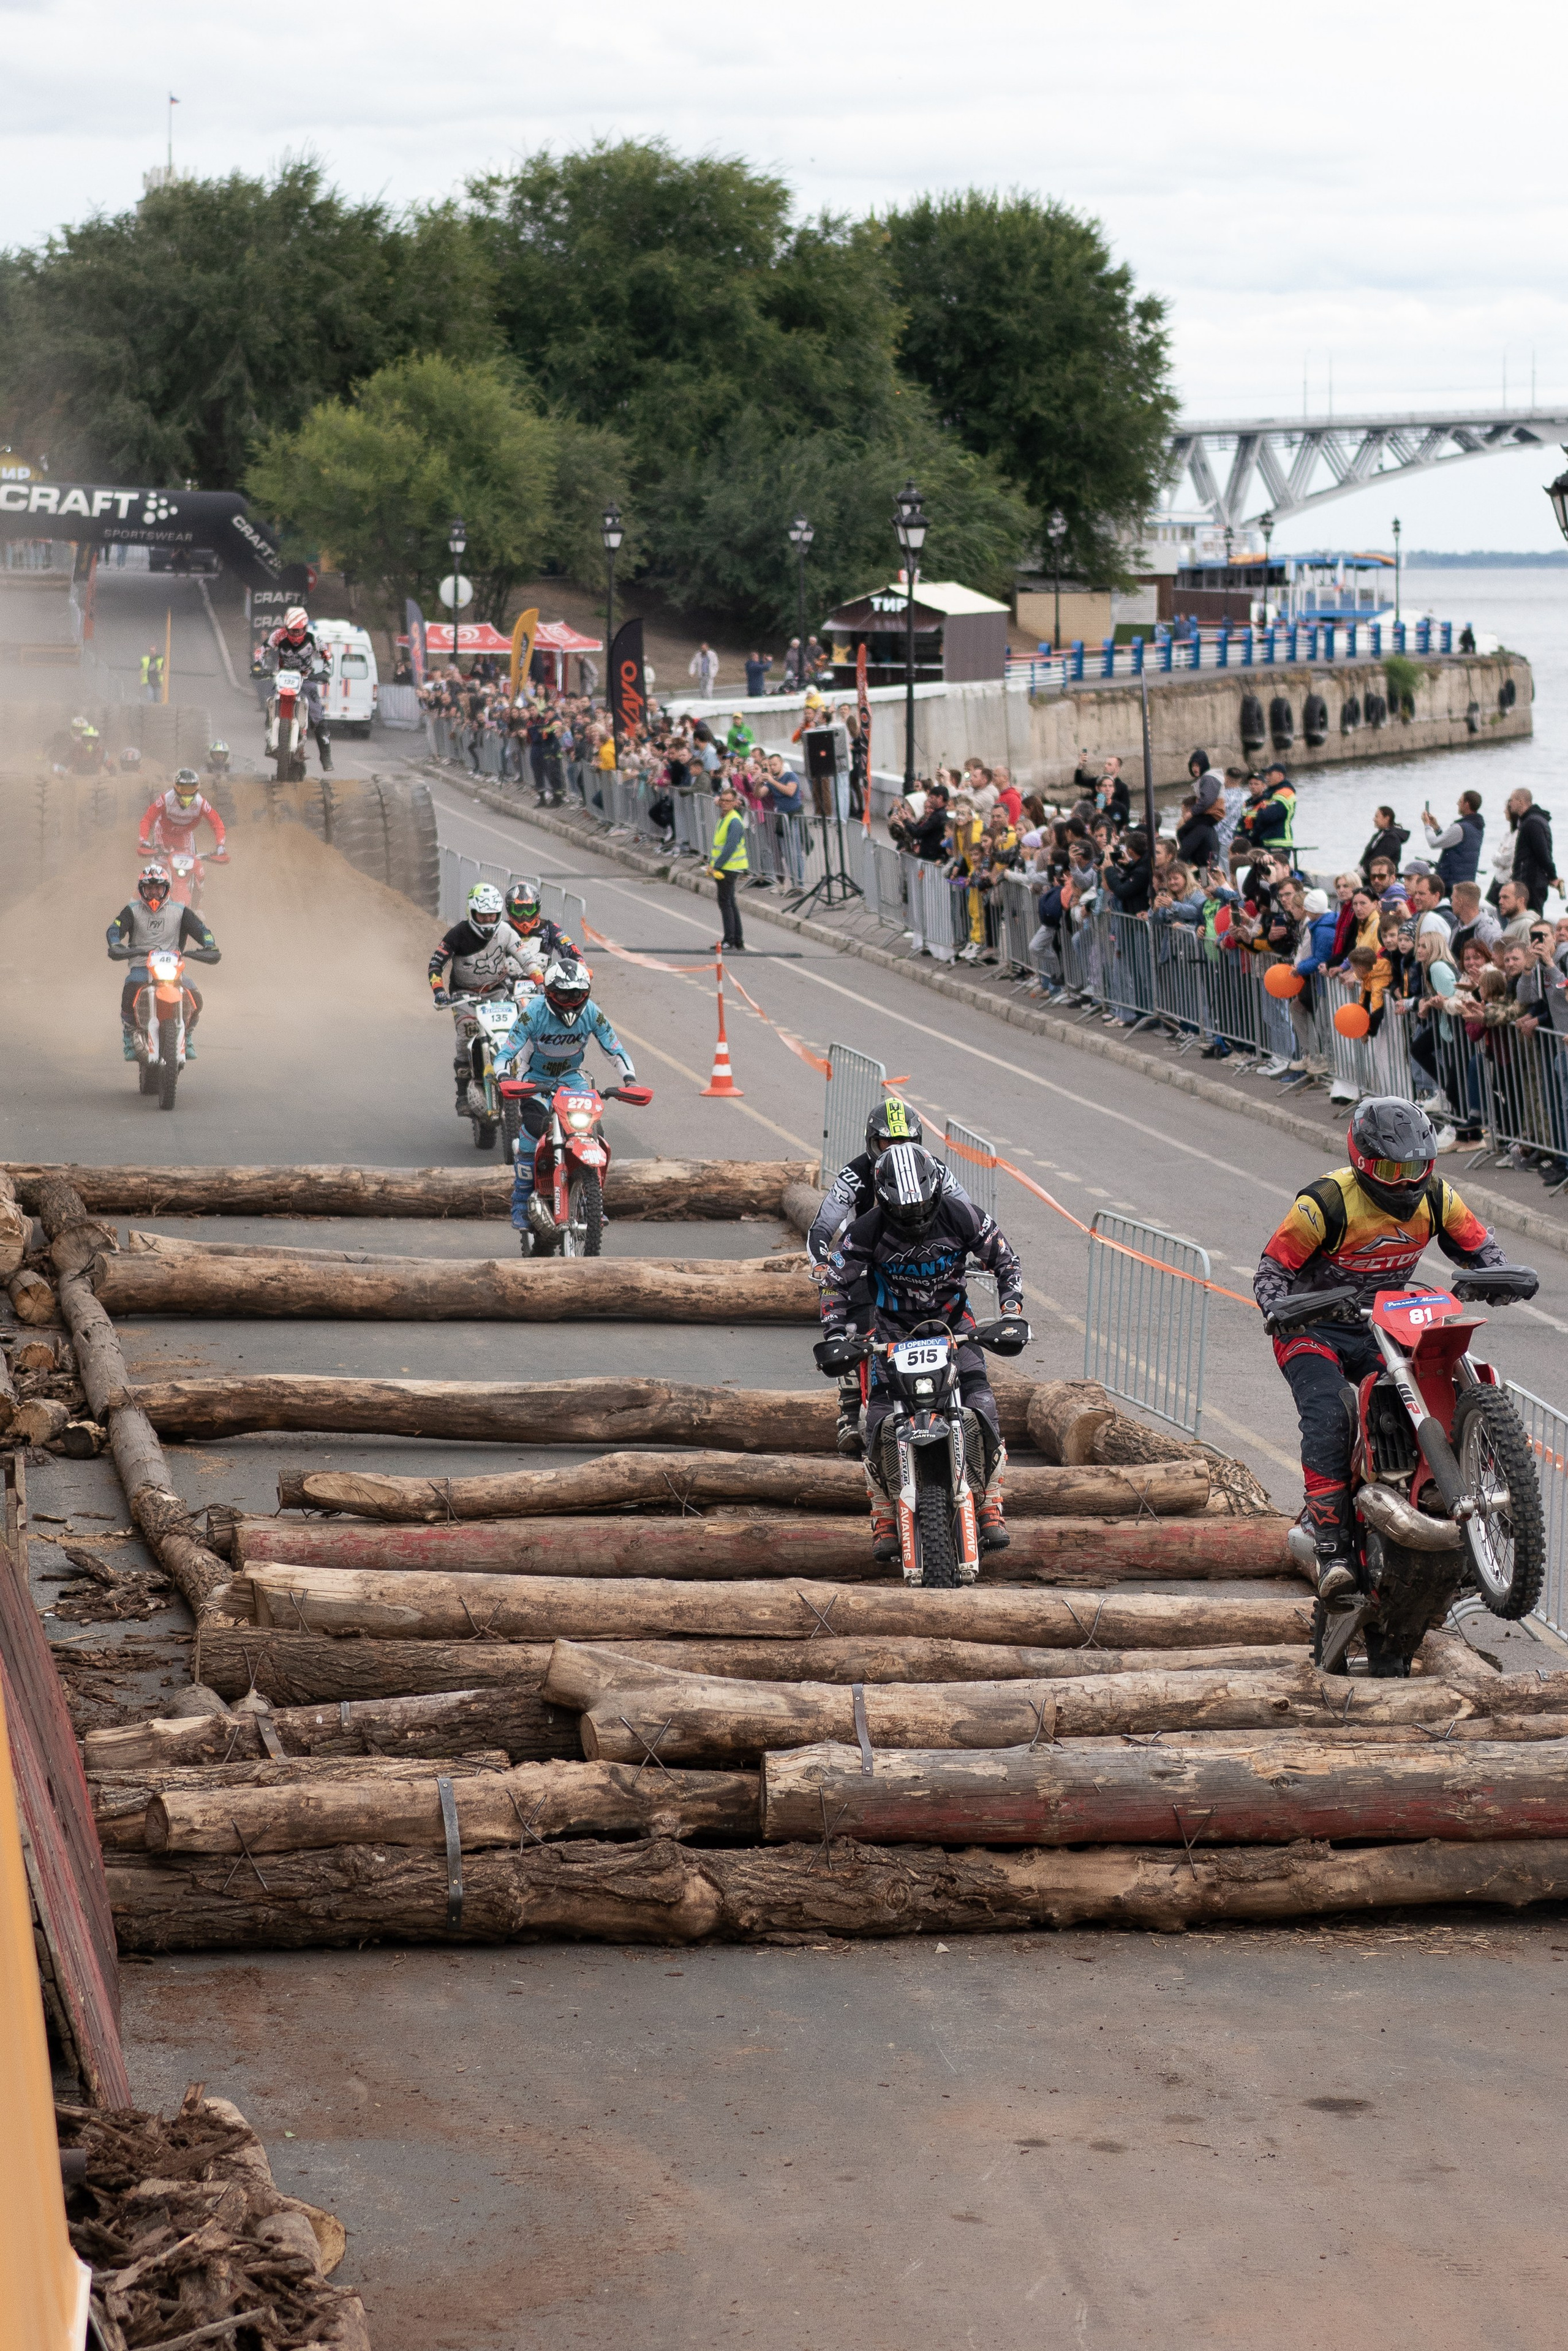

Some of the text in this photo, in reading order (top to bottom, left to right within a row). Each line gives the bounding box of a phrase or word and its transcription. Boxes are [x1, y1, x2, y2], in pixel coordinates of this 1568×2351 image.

[0, 483, 140, 519] CRAFT
[104, 529, 194, 542] SPORTSWEAR
[232, 515, 276, 557] CRAFT
[254, 592, 301, 604] CRAFT
[870, 597, 909, 612] ТИР
[254, 616, 284, 628] CRA
[491, 1014, 508, 1022] 135
[539, 1033, 582, 1046] VECTOR
[567, 1097, 593, 1110] 279
[839, 1166, 865, 1191] FOX
[892, 1275, 930, 1286] RACING
[1409, 1307, 1433, 1325] 81
[907, 1338, 942, 1348] OPENDEV
[907, 1349, 938, 1366] 515
[900, 1506, 911, 1561] AVANTIS
[963, 1500, 976, 1555] AVANTIS
